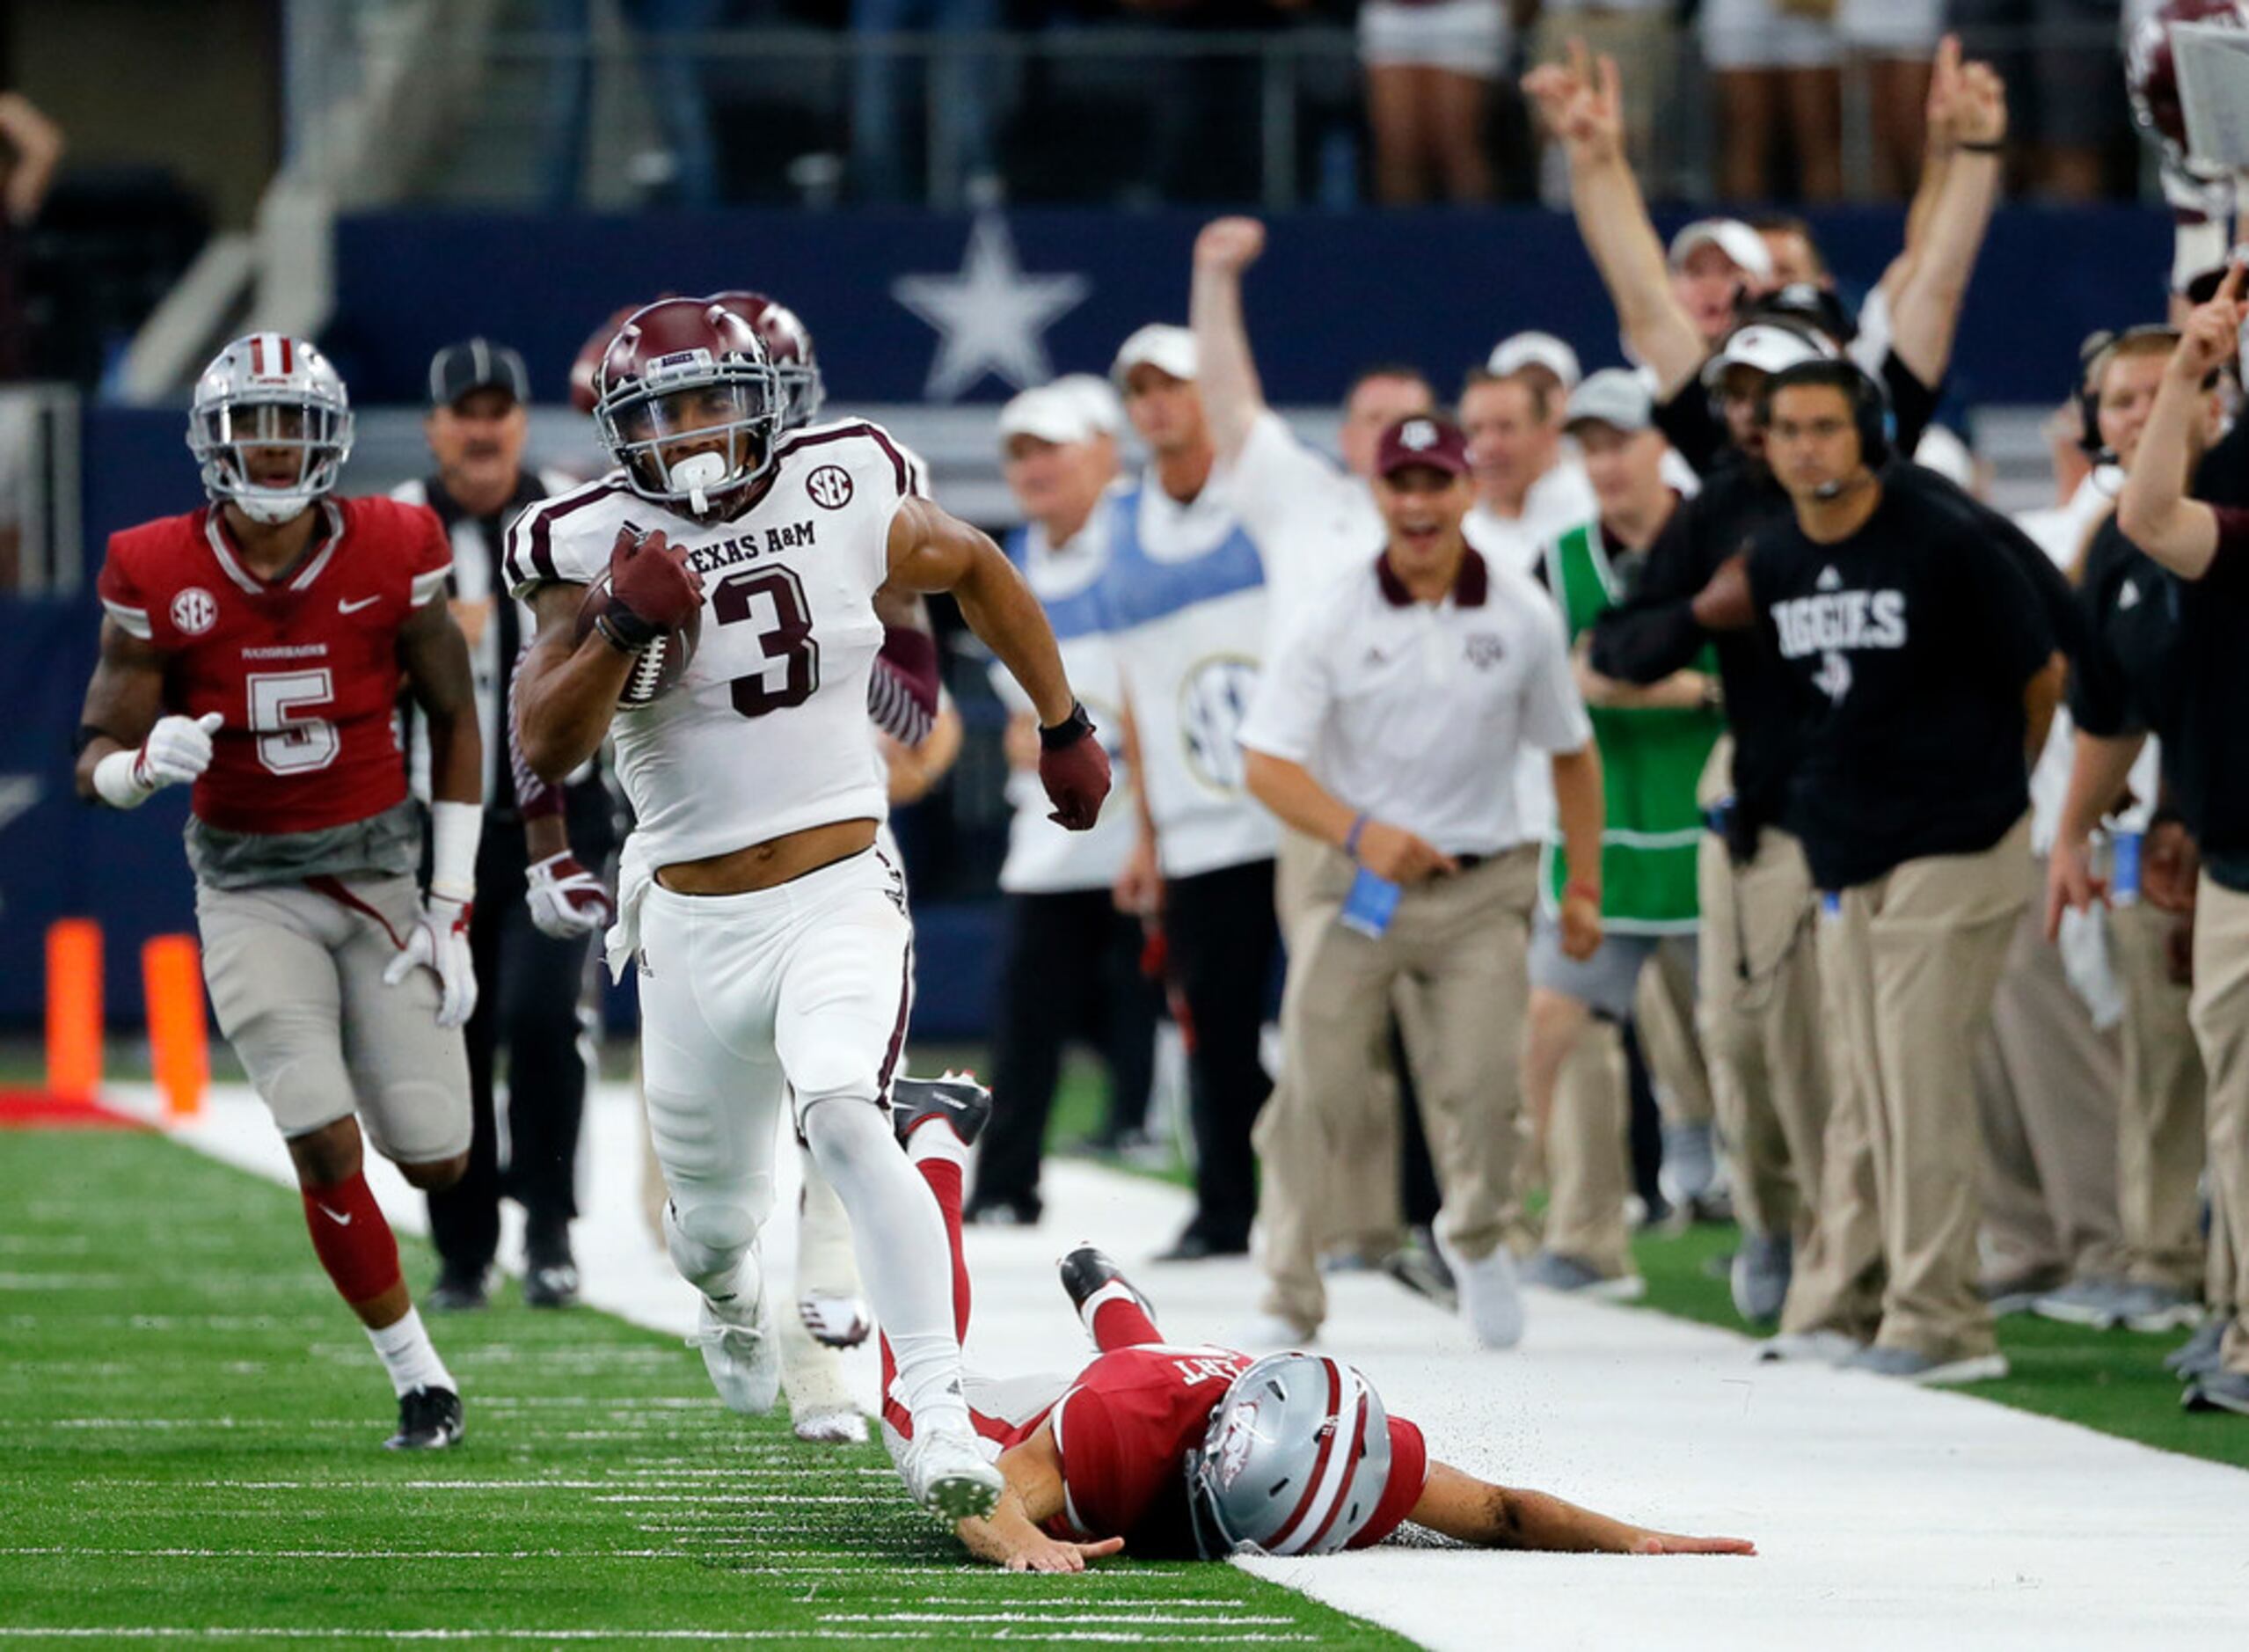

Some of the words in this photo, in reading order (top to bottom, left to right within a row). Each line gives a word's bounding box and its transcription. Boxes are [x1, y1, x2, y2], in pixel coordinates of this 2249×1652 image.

[809, 467, 851, 508] SEC
[690, 535, 759, 574] EXAS
[765, 520, 815, 553] A&M
[174, 589, 215, 632] SEC
[712, 563, 820, 719] 3
[246, 667, 340, 776] 5
